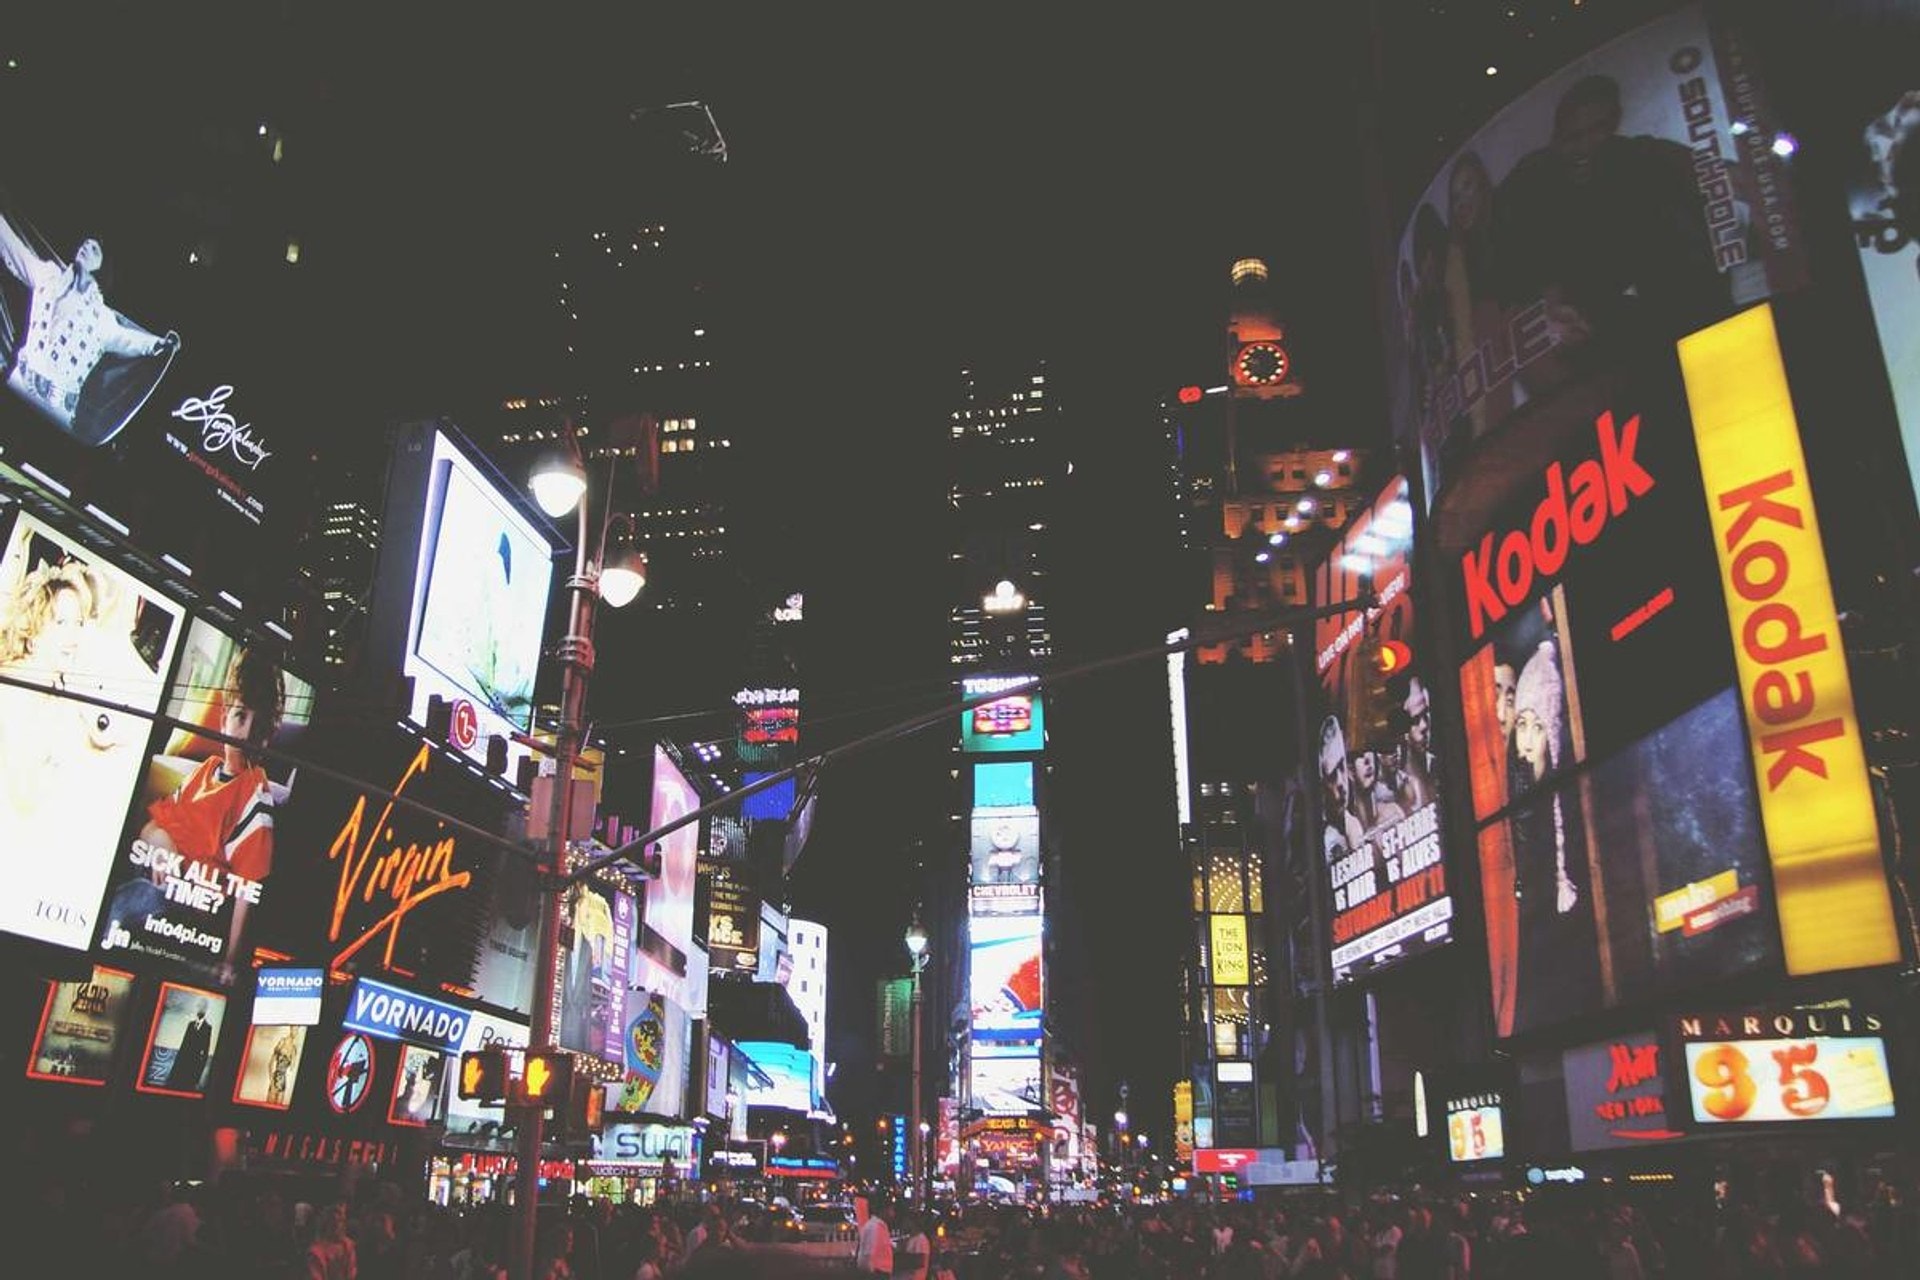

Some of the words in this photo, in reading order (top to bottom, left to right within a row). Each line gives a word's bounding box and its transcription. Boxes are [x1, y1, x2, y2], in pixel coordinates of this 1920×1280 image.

[1677, 76, 1748, 273] SOUTHPOLE
[1461, 410, 1656, 640] Kodak
[1718, 470, 1846, 792] Kodak
[129, 839, 186, 878] SICK
[184, 860, 223, 892] ALL
[226, 872, 264, 905] THE
[328, 742, 472, 980] Virgin
[164, 875, 225, 915] TIME?
[973, 884, 1038, 897] CHEVROLET
[144, 914, 223, 954] info4pi.org
[1216, 941, 1244, 956] LION
[1218, 928, 1241, 938] THE
[257, 975, 323, 987] VORNADO
[1216, 959, 1245, 975] KING
[355, 988, 466, 1043] VORNADO
[1681, 1013, 1884, 1037] MARQUIS
